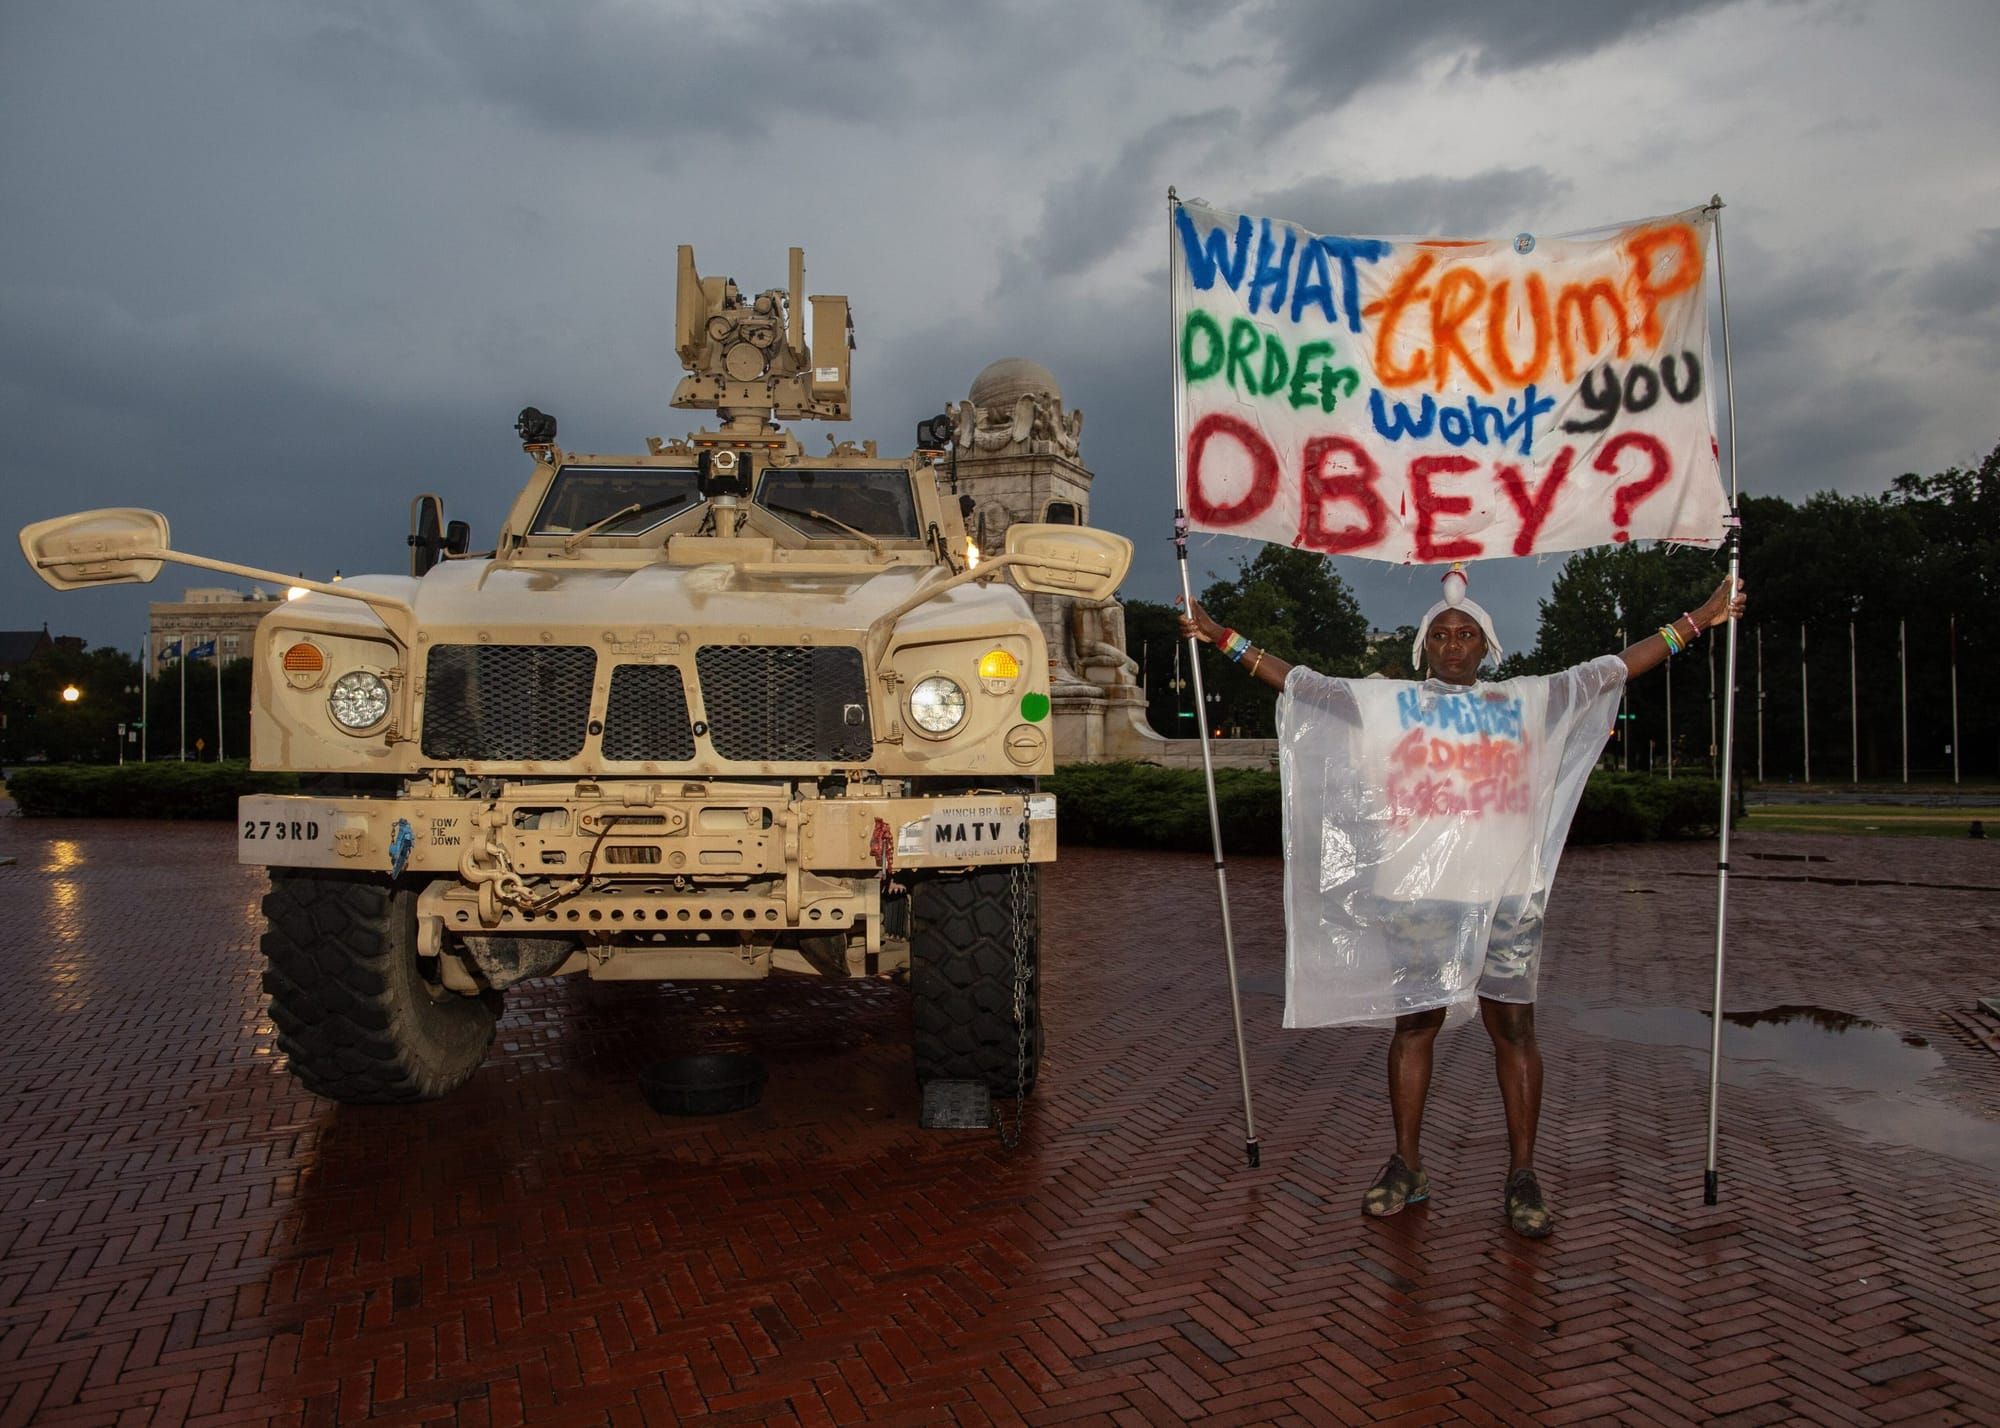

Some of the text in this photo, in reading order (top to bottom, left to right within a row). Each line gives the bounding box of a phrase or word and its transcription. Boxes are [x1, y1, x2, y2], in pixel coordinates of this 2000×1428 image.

[1176, 206, 1392, 333] WHAT
[1561, 351, 1702, 434] you
[942, 806, 1013, 818] WINCH BRAKE
[431, 818, 458, 827] TOW/
[244, 820, 320, 841] 273RD
[431, 827, 446, 836] TIE
[935, 822, 1001, 843] MATV
[431, 836, 461, 846] DOWN
[984, 844, 1028, 856] NEUTRA
